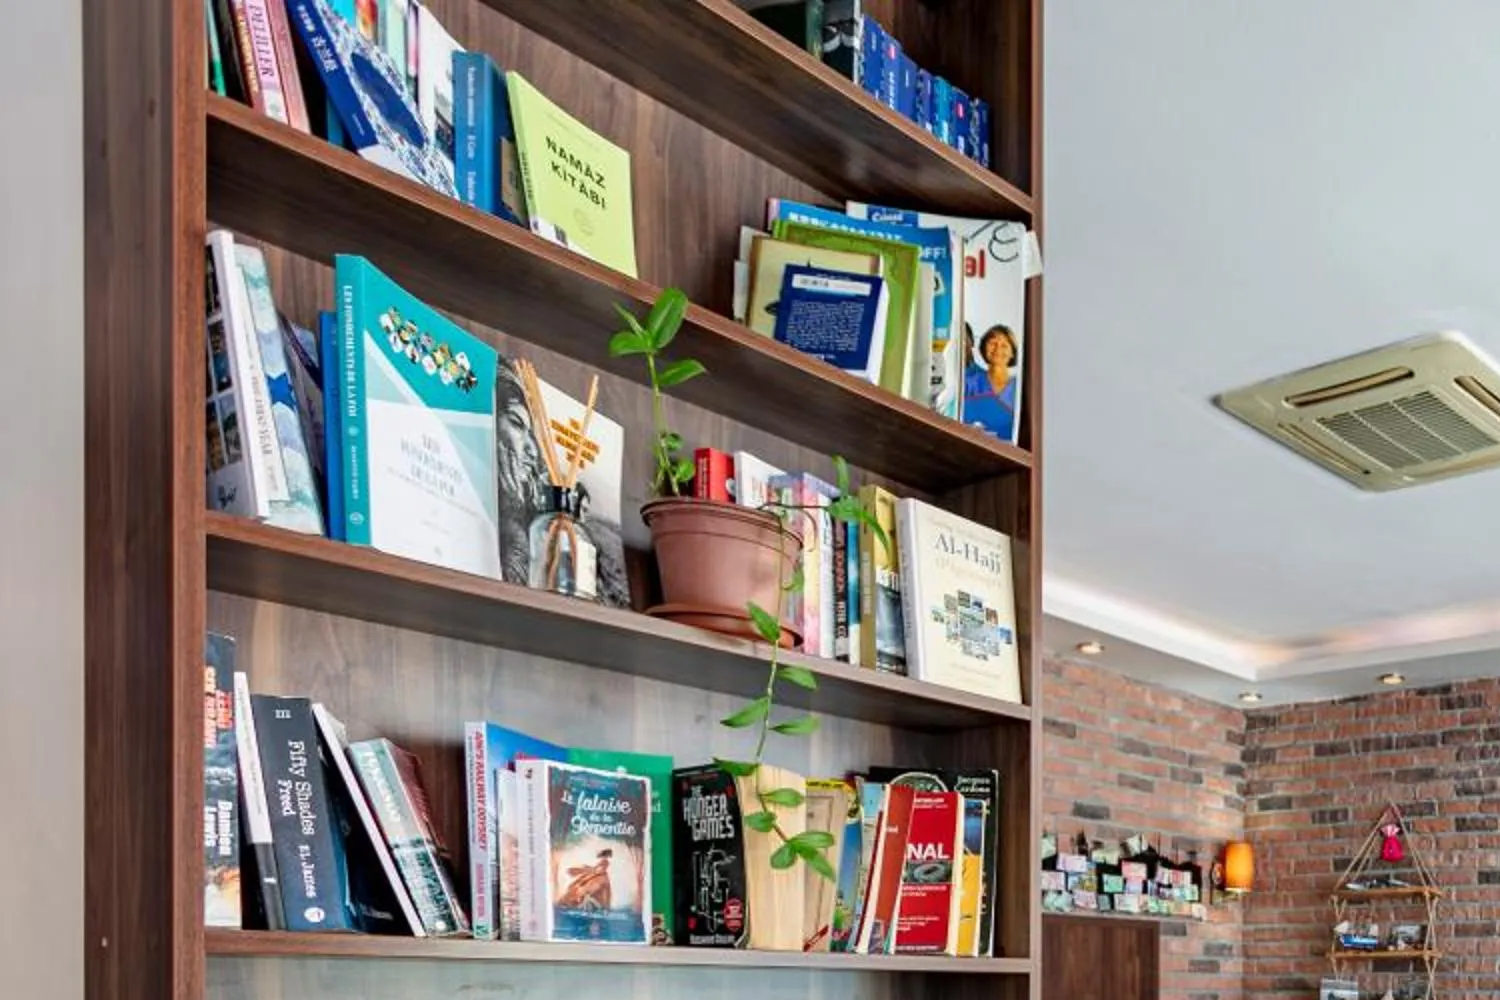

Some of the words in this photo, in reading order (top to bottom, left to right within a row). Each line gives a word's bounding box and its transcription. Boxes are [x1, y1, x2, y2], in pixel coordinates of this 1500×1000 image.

[545, 135, 606, 189] NAMAZ
[288, 739, 305, 779] Fifty
[277, 779, 297, 817] Freed
[295, 781, 315, 837] Shades
[683, 793, 728, 826] HUNGER
[692, 815, 736, 842] GAMES
[301, 861, 317, 899] James
